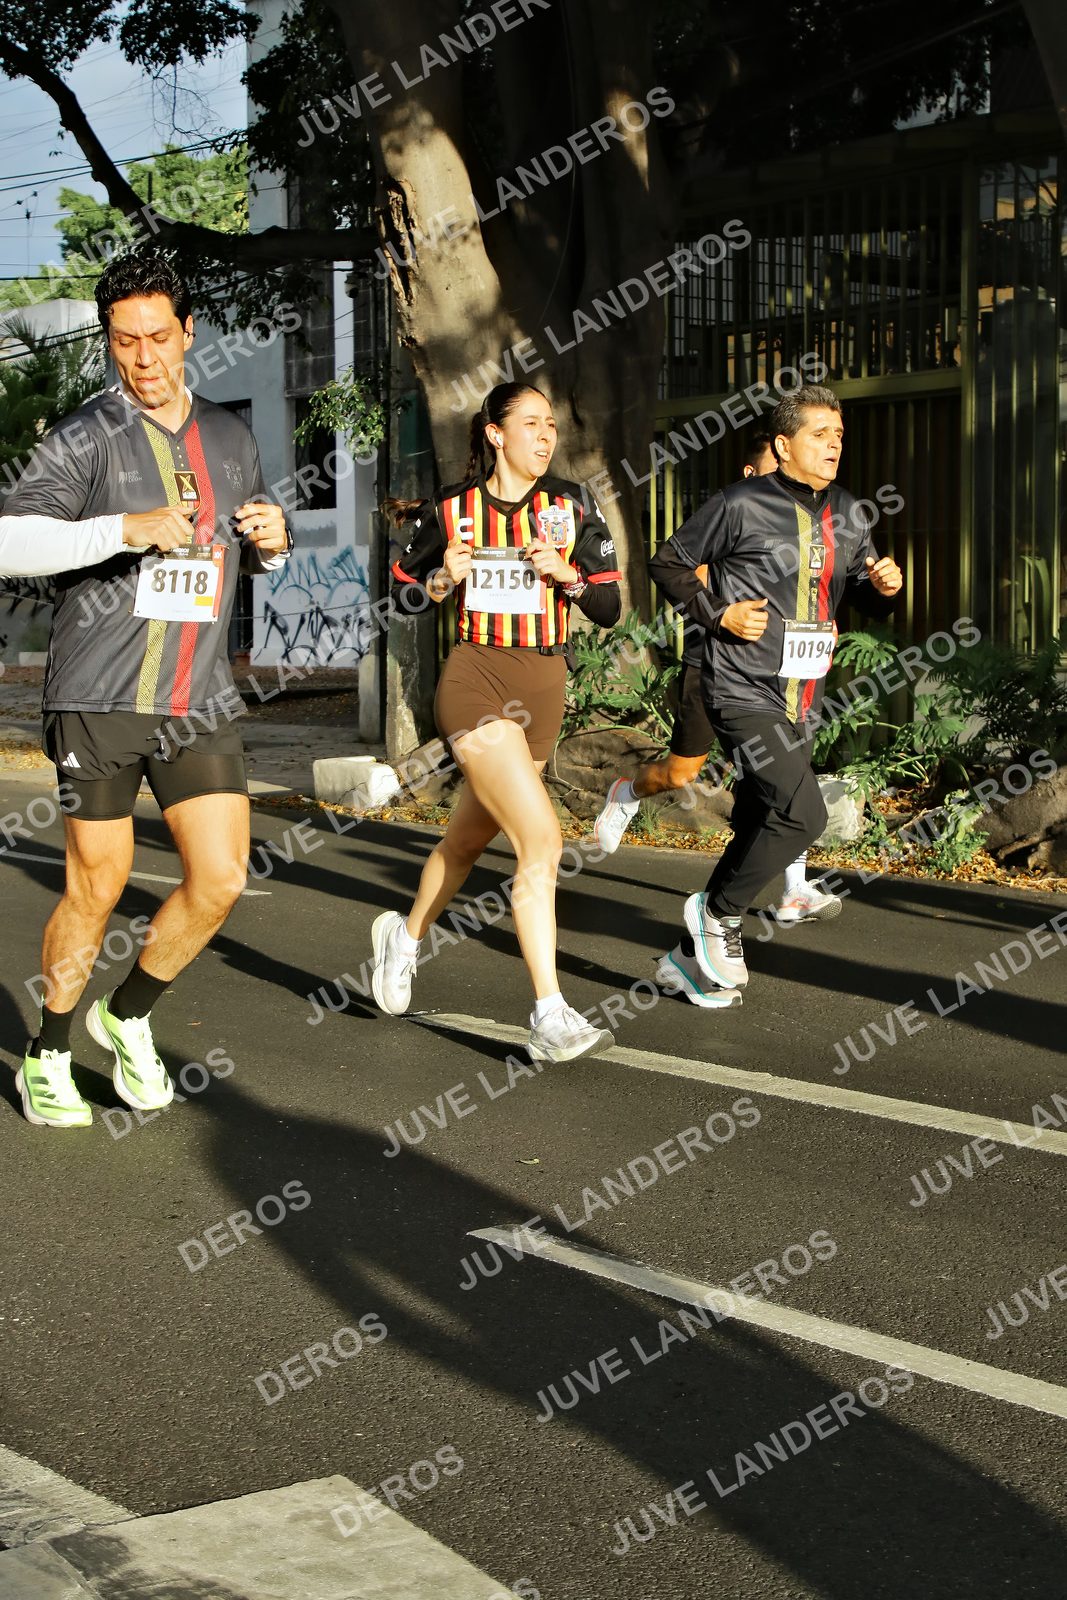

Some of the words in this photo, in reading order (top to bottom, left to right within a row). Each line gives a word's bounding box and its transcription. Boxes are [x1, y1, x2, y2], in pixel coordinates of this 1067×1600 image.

[151, 567, 209, 595] 8118
[471, 567, 536, 591] 12150
[788, 639, 832, 659] 10194
